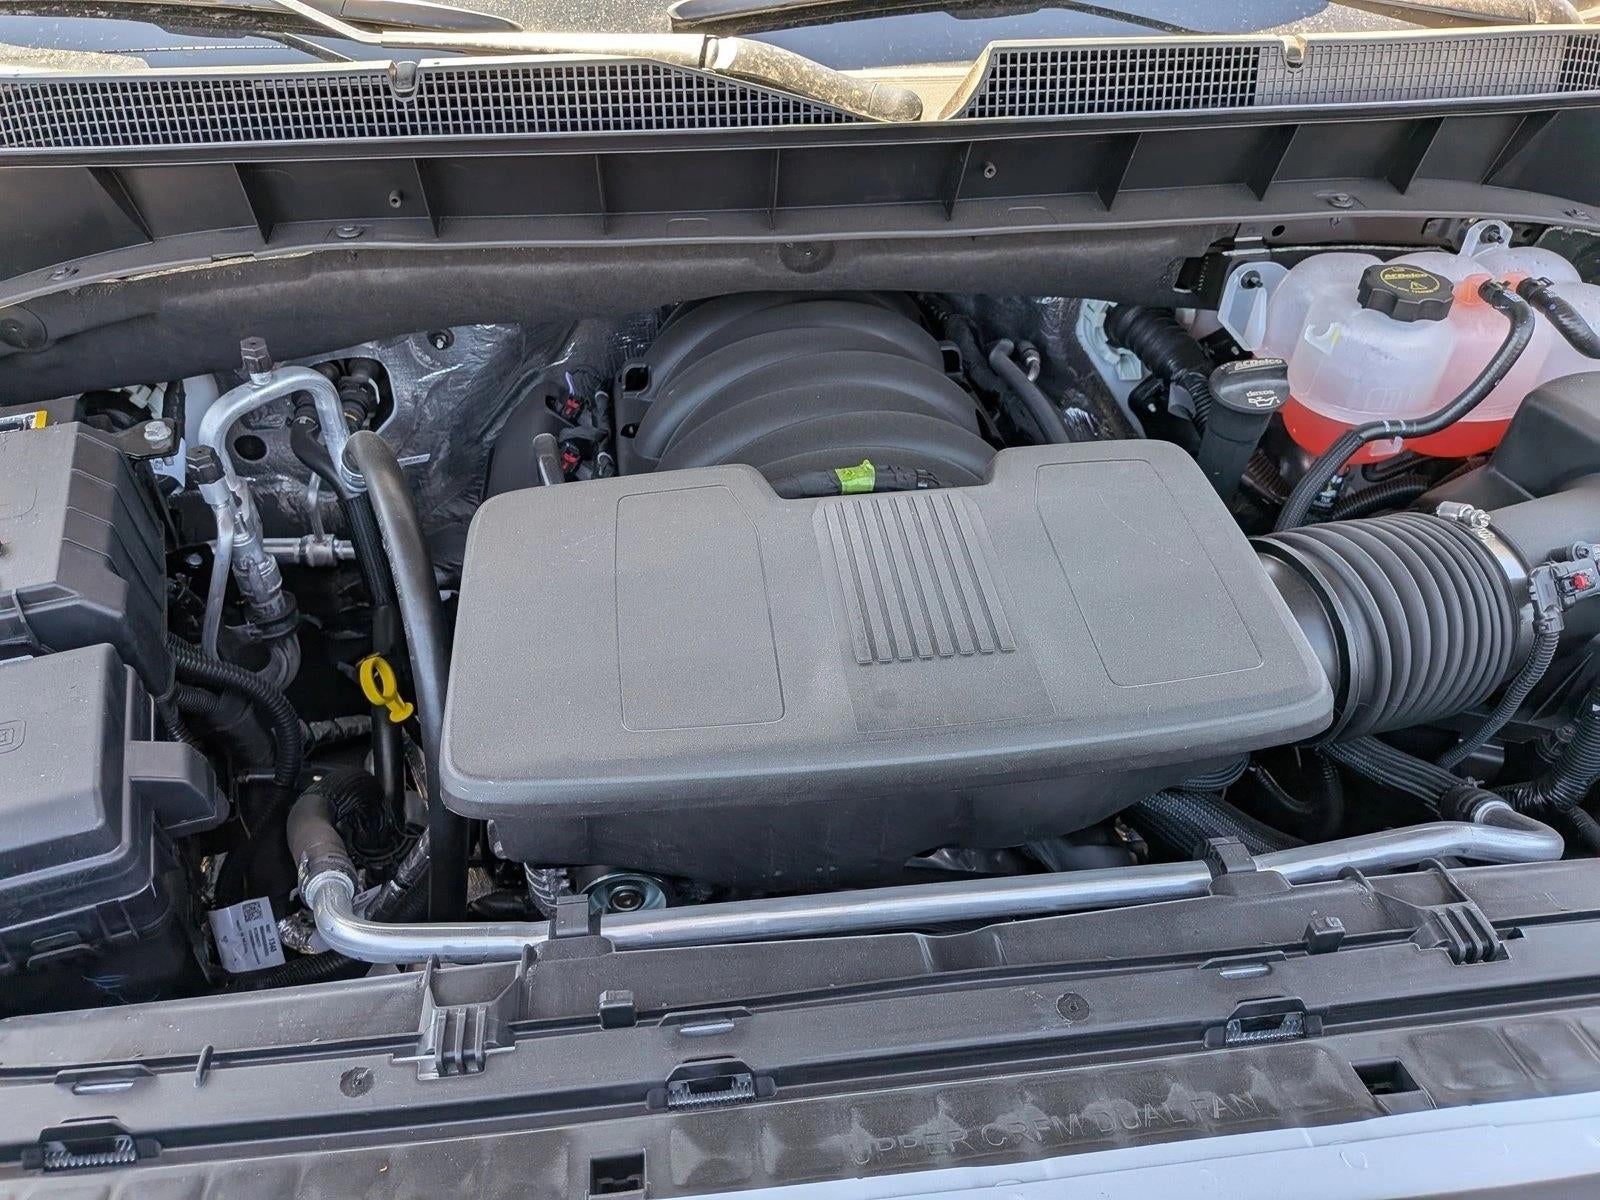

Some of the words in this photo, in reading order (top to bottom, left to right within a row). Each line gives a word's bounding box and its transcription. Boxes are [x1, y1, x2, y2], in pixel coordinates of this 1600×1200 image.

[1383, 272, 1429, 281] ACDelco
[1234, 358, 1283, 371] ACDelco
[1246, 389, 1275, 398] dexos
[854, 1130, 975, 1164] UPPER
[1096, 1102, 1187, 1132] DUAL
[1193, 1092, 1263, 1120] FAN
